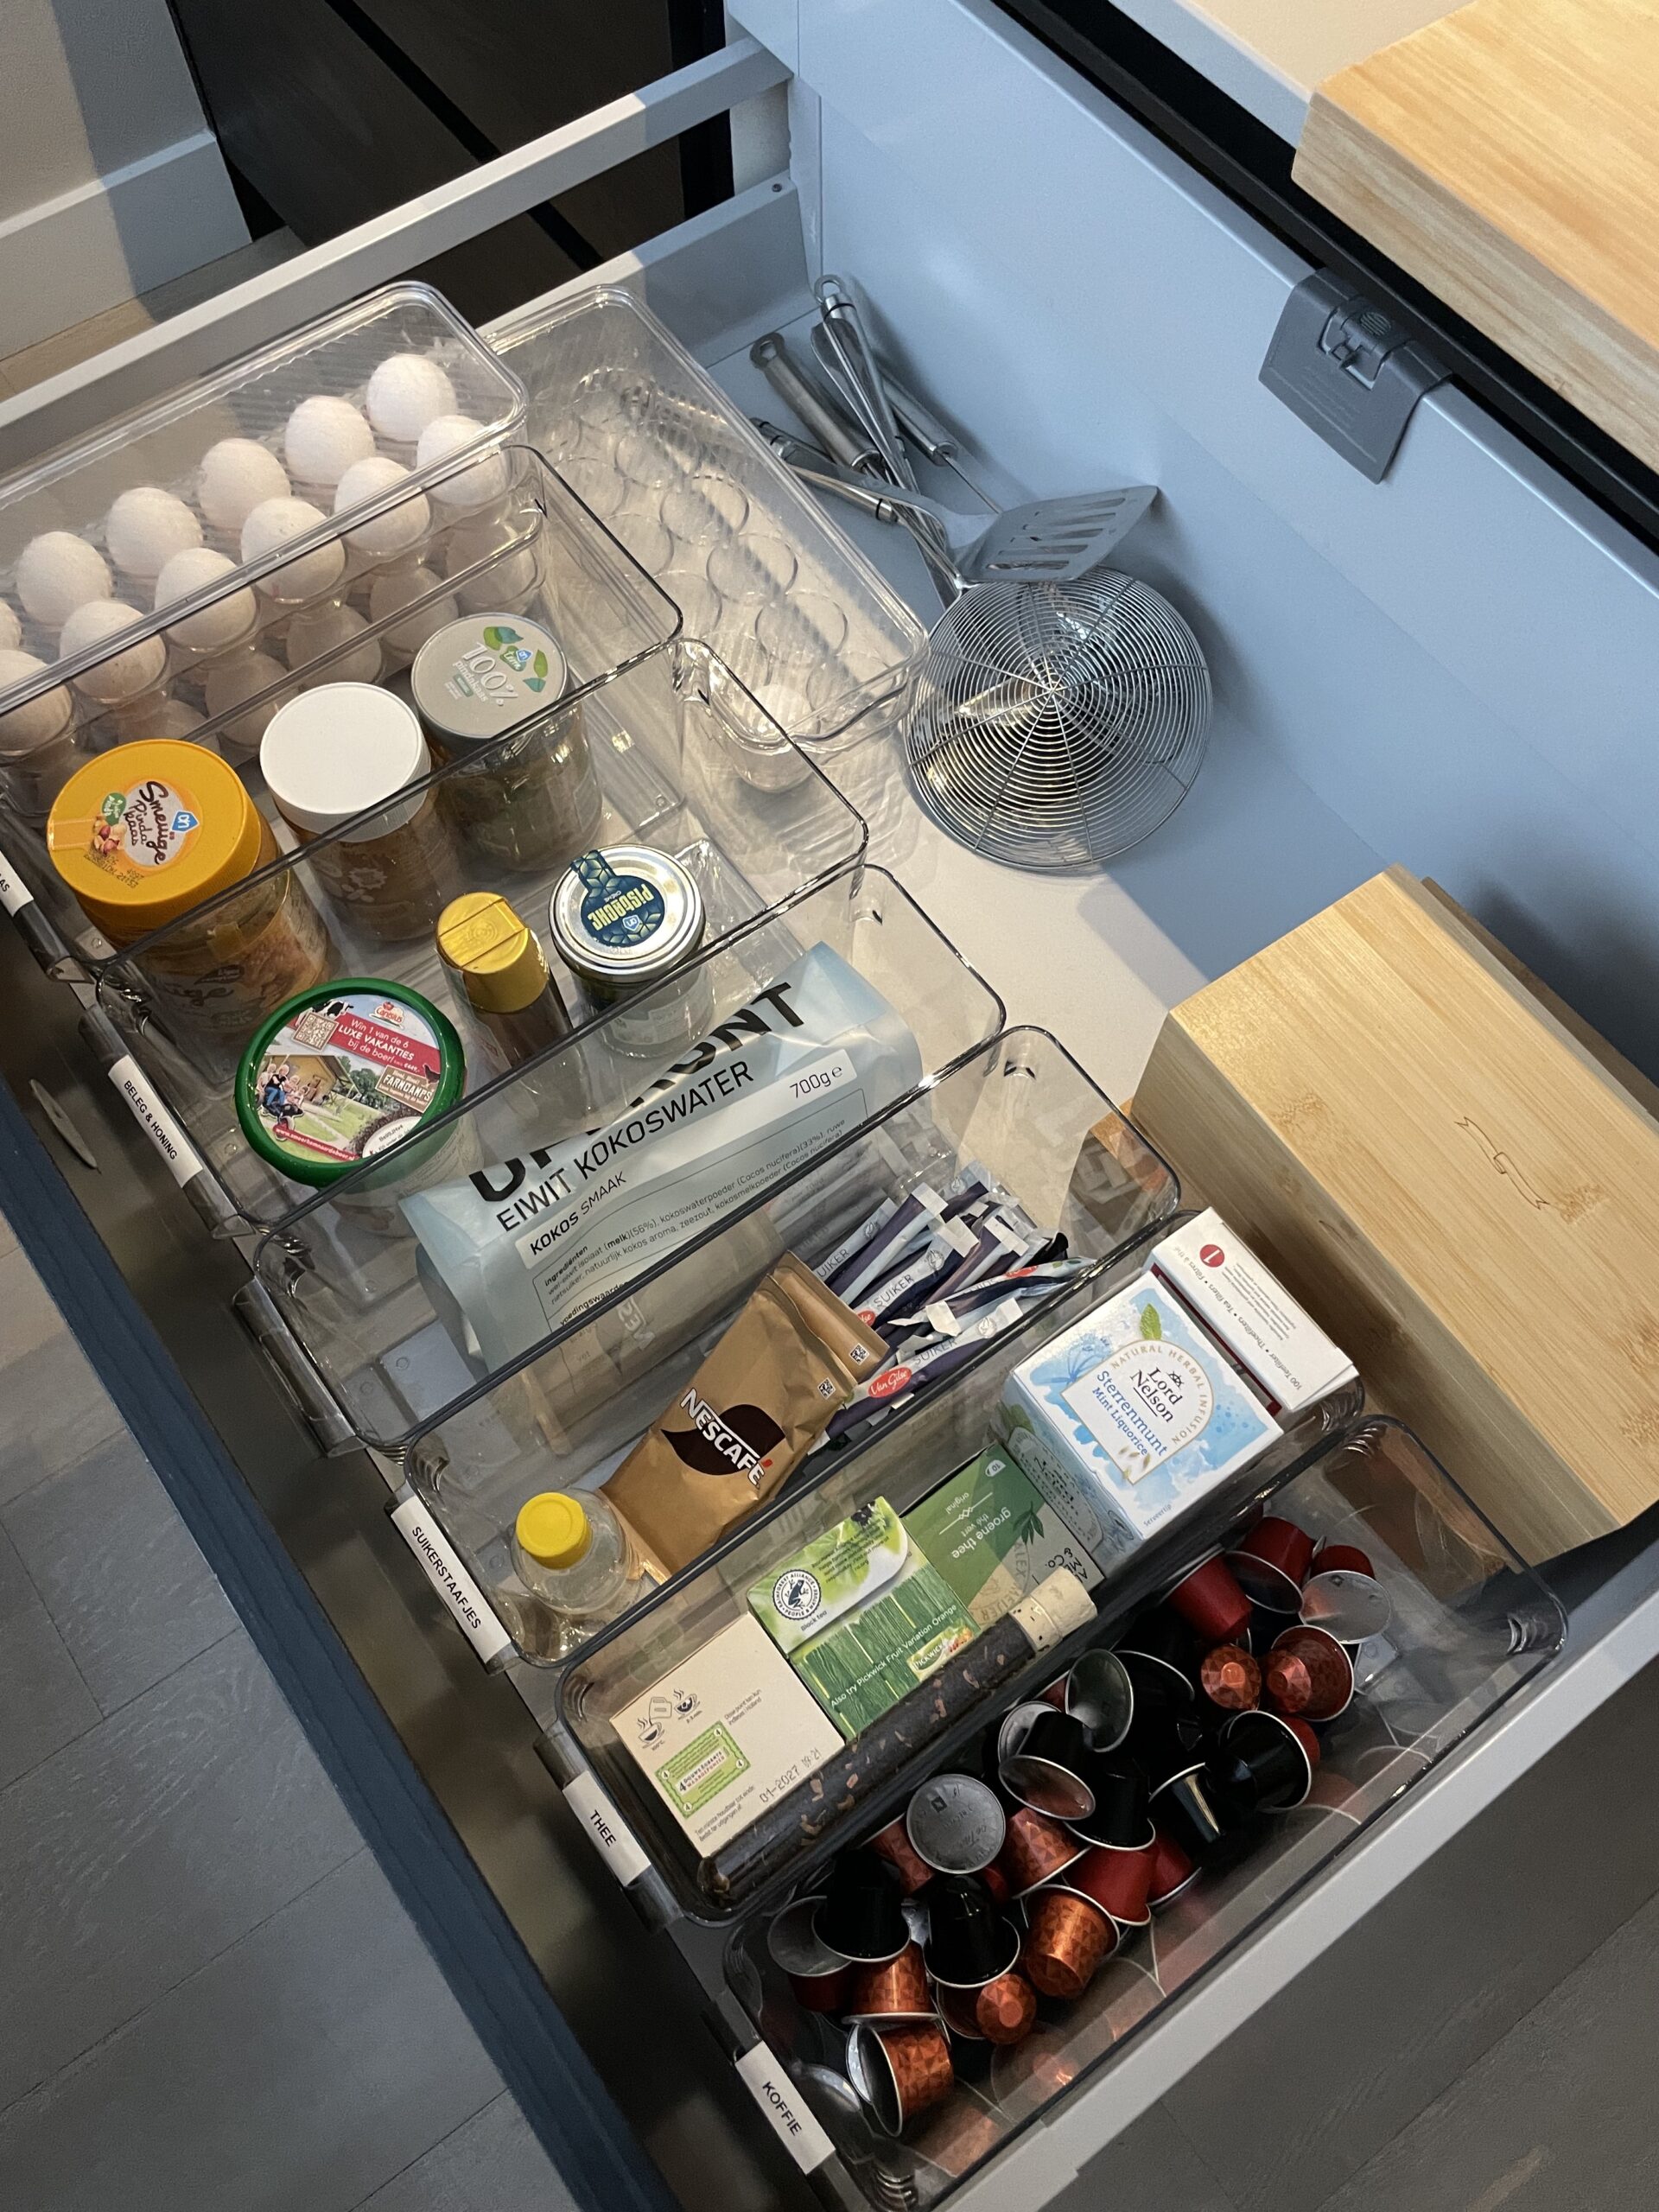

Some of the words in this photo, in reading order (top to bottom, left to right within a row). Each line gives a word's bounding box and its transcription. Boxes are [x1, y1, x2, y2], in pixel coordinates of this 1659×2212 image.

[452, 660, 489, 702] pindakaas
[461, 642, 518, 706] 100%
[124, 810, 139, 846] kaas
[338, 1025, 363, 1039] LUXE
[364, 1034, 415, 1061] VAKANTIES
[347, 1038, 359, 1051] bij
[359, 1044, 371, 1054] de
[351, 1019, 366, 1032] Win
[375, 1029, 390, 1042] van
[391, 1034, 402, 1046] de
[789, 1074, 831, 1098] 700g
[124, 1079, 147, 1114] BELEG
[145, 1112, 153, 1122] &
[150, 1122, 177, 1161] HONING
[496, 1167, 571, 1231] EIWIT
[573, 1061, 753, 1180] KOKOSWATER
[530, 1211, 579, 1255] KOKOS
[581, 1171, 626, 1215] SMAAK
[577, 1247, 602, 1268] isolaat
[660, 1182, 736, 1224] kokoswaterpoeder
[736, 1166, 765, 1186] (Cocos
[585, 1250, 622, 1277] natuurlijk
[623, 1238, 648, 1255] kokos
[715, 1168, 781, 1210] kokosmelkpoeder
[783, 1152, 809, 1172] (Cocos
[810, 1129, 842, 1154] nucifera)
[817, 1248, 849, 1278] UIKER
[1204, 1249, 1221, 1263] 1
[874, 1274, 915, 1307] SUIKER
[1209, 1283, 1224, 1301] filters
[1224, 1300, 1235, 1313] Tea
[1238, 1316, 1265, 1350] Theefilters
[912, 1337, 957, 1365] SUIKER
[1111, 1344, 1162, 1369] NATURAL
[1269, 1352, 1293, 1379] Teefilter
[870, 1382, 888, 1395] Van
[887, 1370, 908, 1390] Gilse
[1147, 1367, 1183, 1405] Lord
[1169, 1350, 1205, 1389] HERBAL
[1290, 1377, 1302, 1390] 100
[1097, 1370, 1167, 1456] Sterrenmunt
[1129, 1370, 1174, 1423] Nelson
[1092, 1387, 1113, 1411] Mint
[1111, 1409, 1148, 1456] Liquorice
[1172, 1395, 1207, 1445] INFUSION
[680, 1388, 773, 1489] NESCAFÉ
[993, 1462, 1001, 1471] 10
[945, 1492, 969, 1515] original
[960, 1522, 977, 1537] vert
[976, 1507, 1011, 1540] groene
[951, 1537, 977, 1559] thee
[1045, 1554, 1065, 1568] Co.
[411, 1525, 481, 1630] SUIKERSTAAFJES
[800, 1615, 817, 1631] Black
[817, 1610, 828, 1620] tea
[831, 1693, 847, 1707] Also
[846, 1685, 858, 1696] try
[856, 1661, 887, 1687] Pickwick
[886, 1647, 903, 1663] Fruit
[902, 1624, 933, 1649] Variation
[931, 1604, 957, 1626] Orange
[678, 1779, 687, 1793] 4
[759, 1764, 800, 1803] 01-2027
[589, 1808, 617, 1847] THEE
[762, 2081, 803, 2137] KOFFIE
